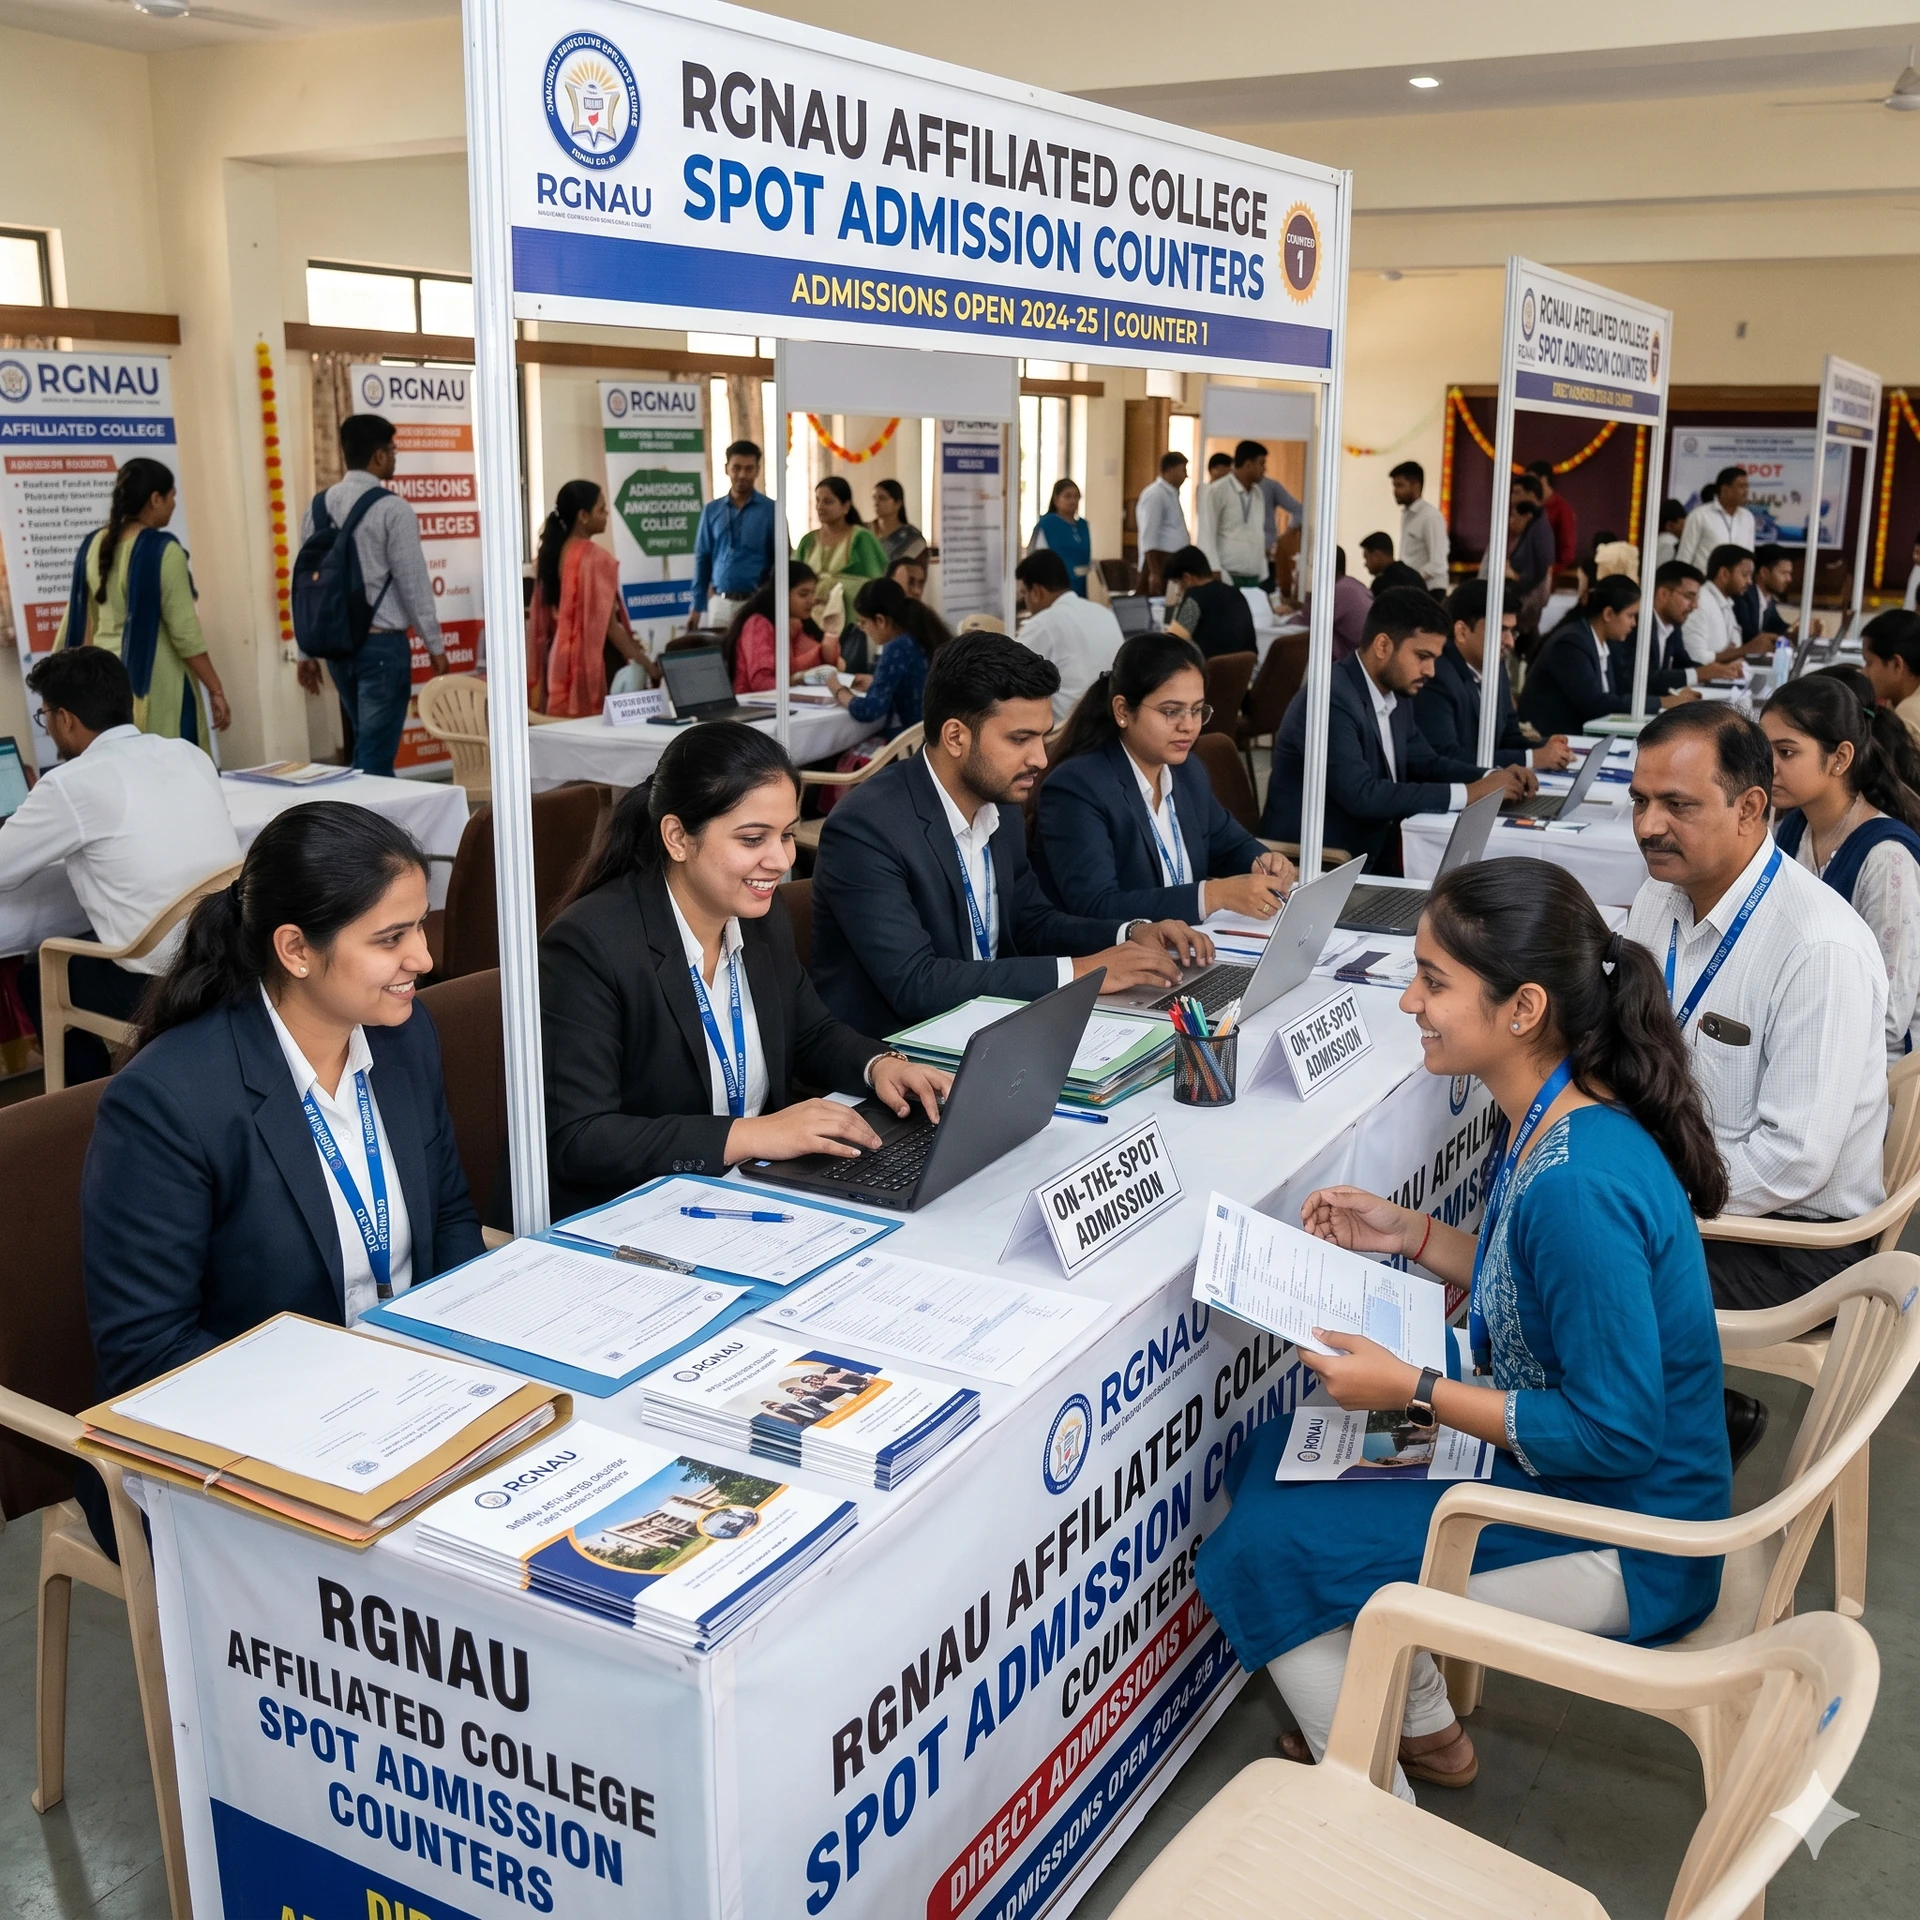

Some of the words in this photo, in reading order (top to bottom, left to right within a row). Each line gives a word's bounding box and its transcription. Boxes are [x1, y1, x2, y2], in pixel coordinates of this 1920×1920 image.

[682, 60, 867, 160] RGNAU
[882, 108, 1118, 208] AFFILIATED
[1129, 164, 1267, 240] COLLEGE
[537, 172, 652, 218] RGNAU
[683, 153, 824, 236] SPOT
[837, 181, 1080, 273] ADMISSION
[1093, 226, 1265, 300] COUNTERS
[1297, 250, 1304, 278] 1
[791, 273, 948, 319] ADMISSIONS
[953, 291, 1014, 326] OPEN
[1020, 299, 1098, 334] 2024-25
[1114, 311, 1197, 344] COUNTER
[1201, 322, 1208, 346] 1
[1539, 294, 1573, 329] RGNAU
[1573, 306, 1618, 342] AFFILIATED
[1618, 319, 1650, 351] COLLEGE
[37, 363, 160, 396] RGNAU
[389, 377, 465, 401] RGNAU
[1538, 333, 1563, 366] SPOT
[1563, 340, 1610, 375] ADMISSION
[1610, 351, 1648, 382] COUNTERS
[100, 423, 166, 437] COLLEGE
[631, 391, 696, 412] RGNAU
[1290, 997, 1358, 1056] ON-THE-SPOT
[1305, 1026, 1363, 1082] ADMISSION
[1052, 1132, 1160, 1221] ON-THE-SPOT
[1076, 1171, 1165, 1251] ADMISSION
[692, 1341, 744, 1373] RGNAU
[1101, 1301, 1210, 1428] RGNAU
[502, 1450, 578, 1494] RGNAU
[833, 1591, 991, 1797] RGNAU
[1005, 1393, 1203, 1630] AFFILIATED
[317, 1576, 531, 1713] RGNAU
[805, 1715, 949, 1916] SPOT
[963, 1470, 1192, 1762] ADMISSION
[227, 1629, 445, 1750] AFFILIATED
[461, 1720, 657, 1839] COLLEGE
[950, 1775, 1042, 1911] DIRECT
[1048, 1620, 1180, 1800] ADMISSIONS
[1108, 1733, 1149, 1802] OPEN
[258, 1695, 359, 1774] SPOT
[375, 1743, 624, 1887] ADMISSION
[328, 1781, 554, 1914] COUNTERS
